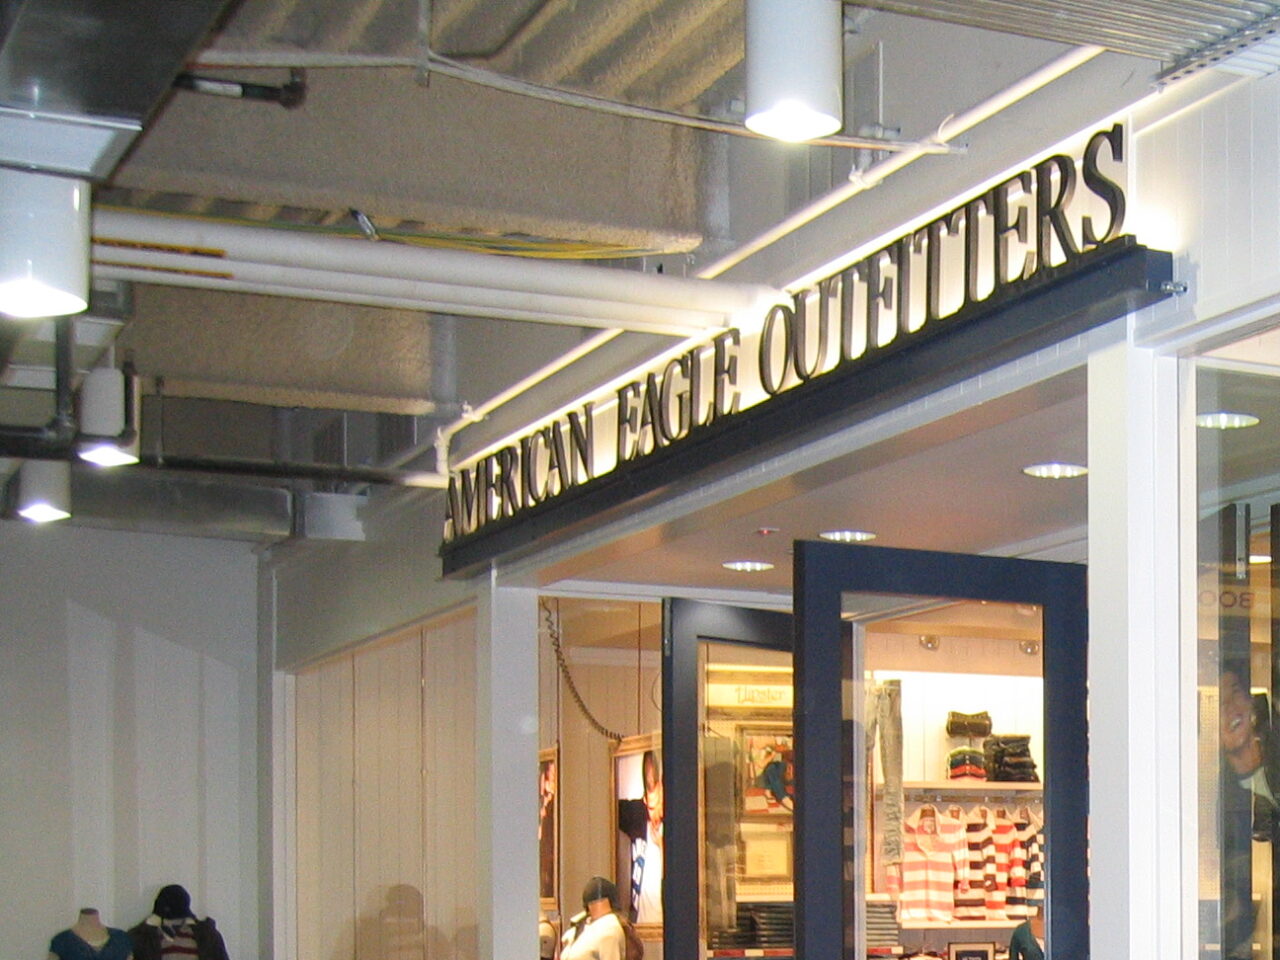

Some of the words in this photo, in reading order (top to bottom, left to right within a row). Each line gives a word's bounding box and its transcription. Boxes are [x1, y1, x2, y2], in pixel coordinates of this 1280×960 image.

[442, 402, 595, 544] AMERICAN
[615, 327, 742, 462] EAGLE
[758, 122, 1127, 396] OUTFITTERS
